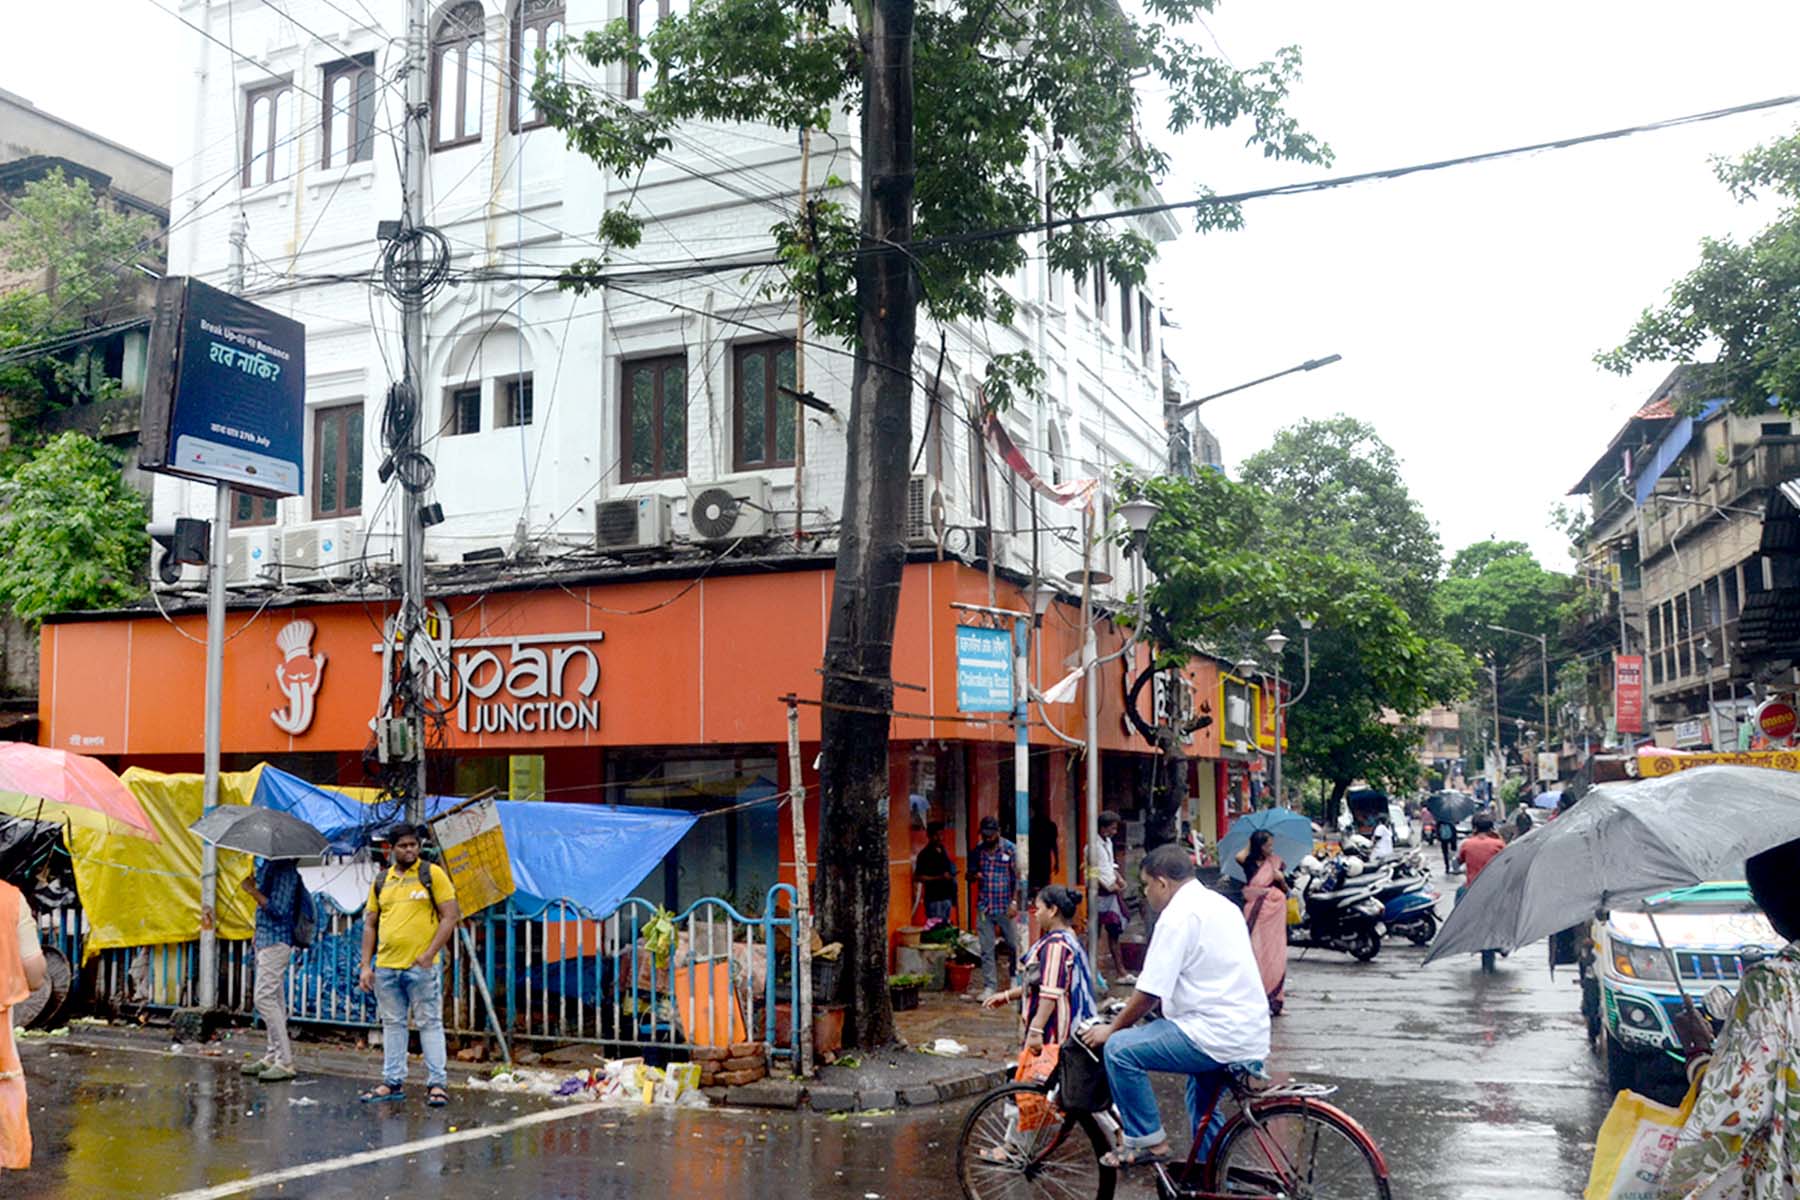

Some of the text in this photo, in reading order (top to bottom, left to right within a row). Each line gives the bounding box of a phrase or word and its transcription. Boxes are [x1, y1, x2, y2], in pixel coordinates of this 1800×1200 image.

[200, 319, 223, 336] Break
[257, 340, 290, 361] Romance
[208, 341, 281, 382] হবে নাকি?
[255, 433, 271, 448] July
[1618, 674, 1640, 686] SALE
[471, 699, 600, 734] JUNCTION
